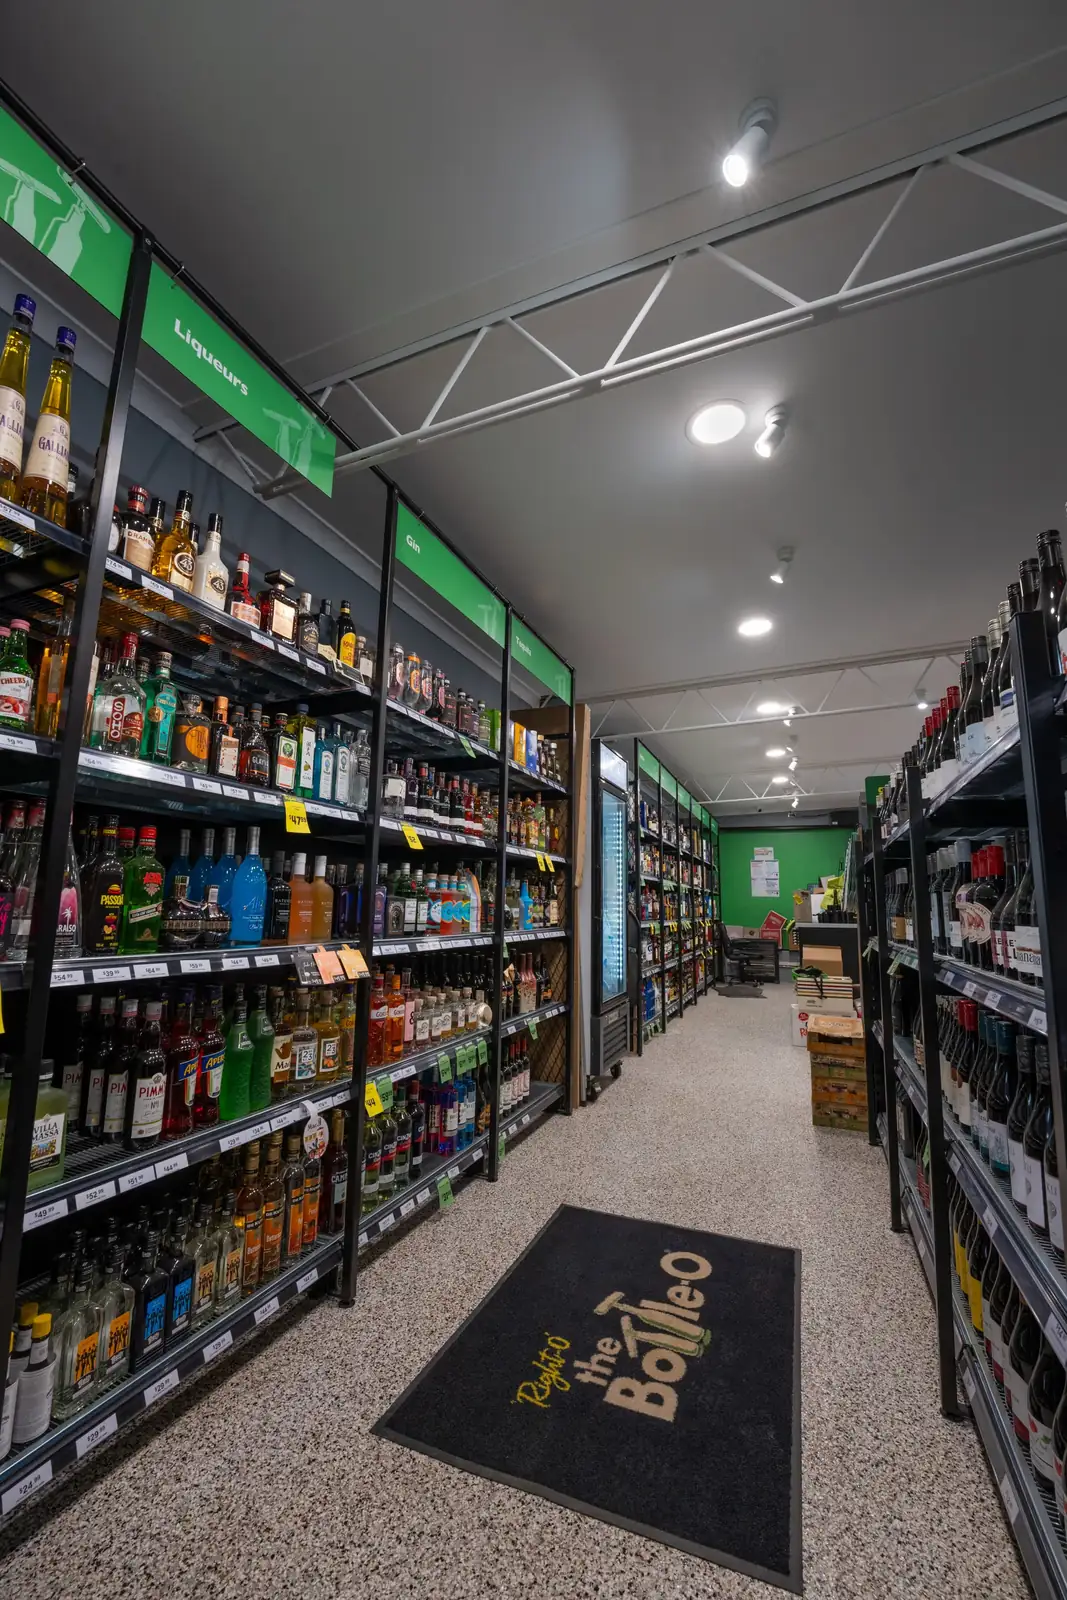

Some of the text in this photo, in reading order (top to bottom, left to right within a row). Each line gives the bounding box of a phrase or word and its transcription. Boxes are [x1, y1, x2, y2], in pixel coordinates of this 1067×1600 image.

[174, 317, 249, 396] Liqueurs
[405, 534, 421, 554] Gin
[110, 701, 124, 739] SOHO
[574, 1337, 621, 1386] the
